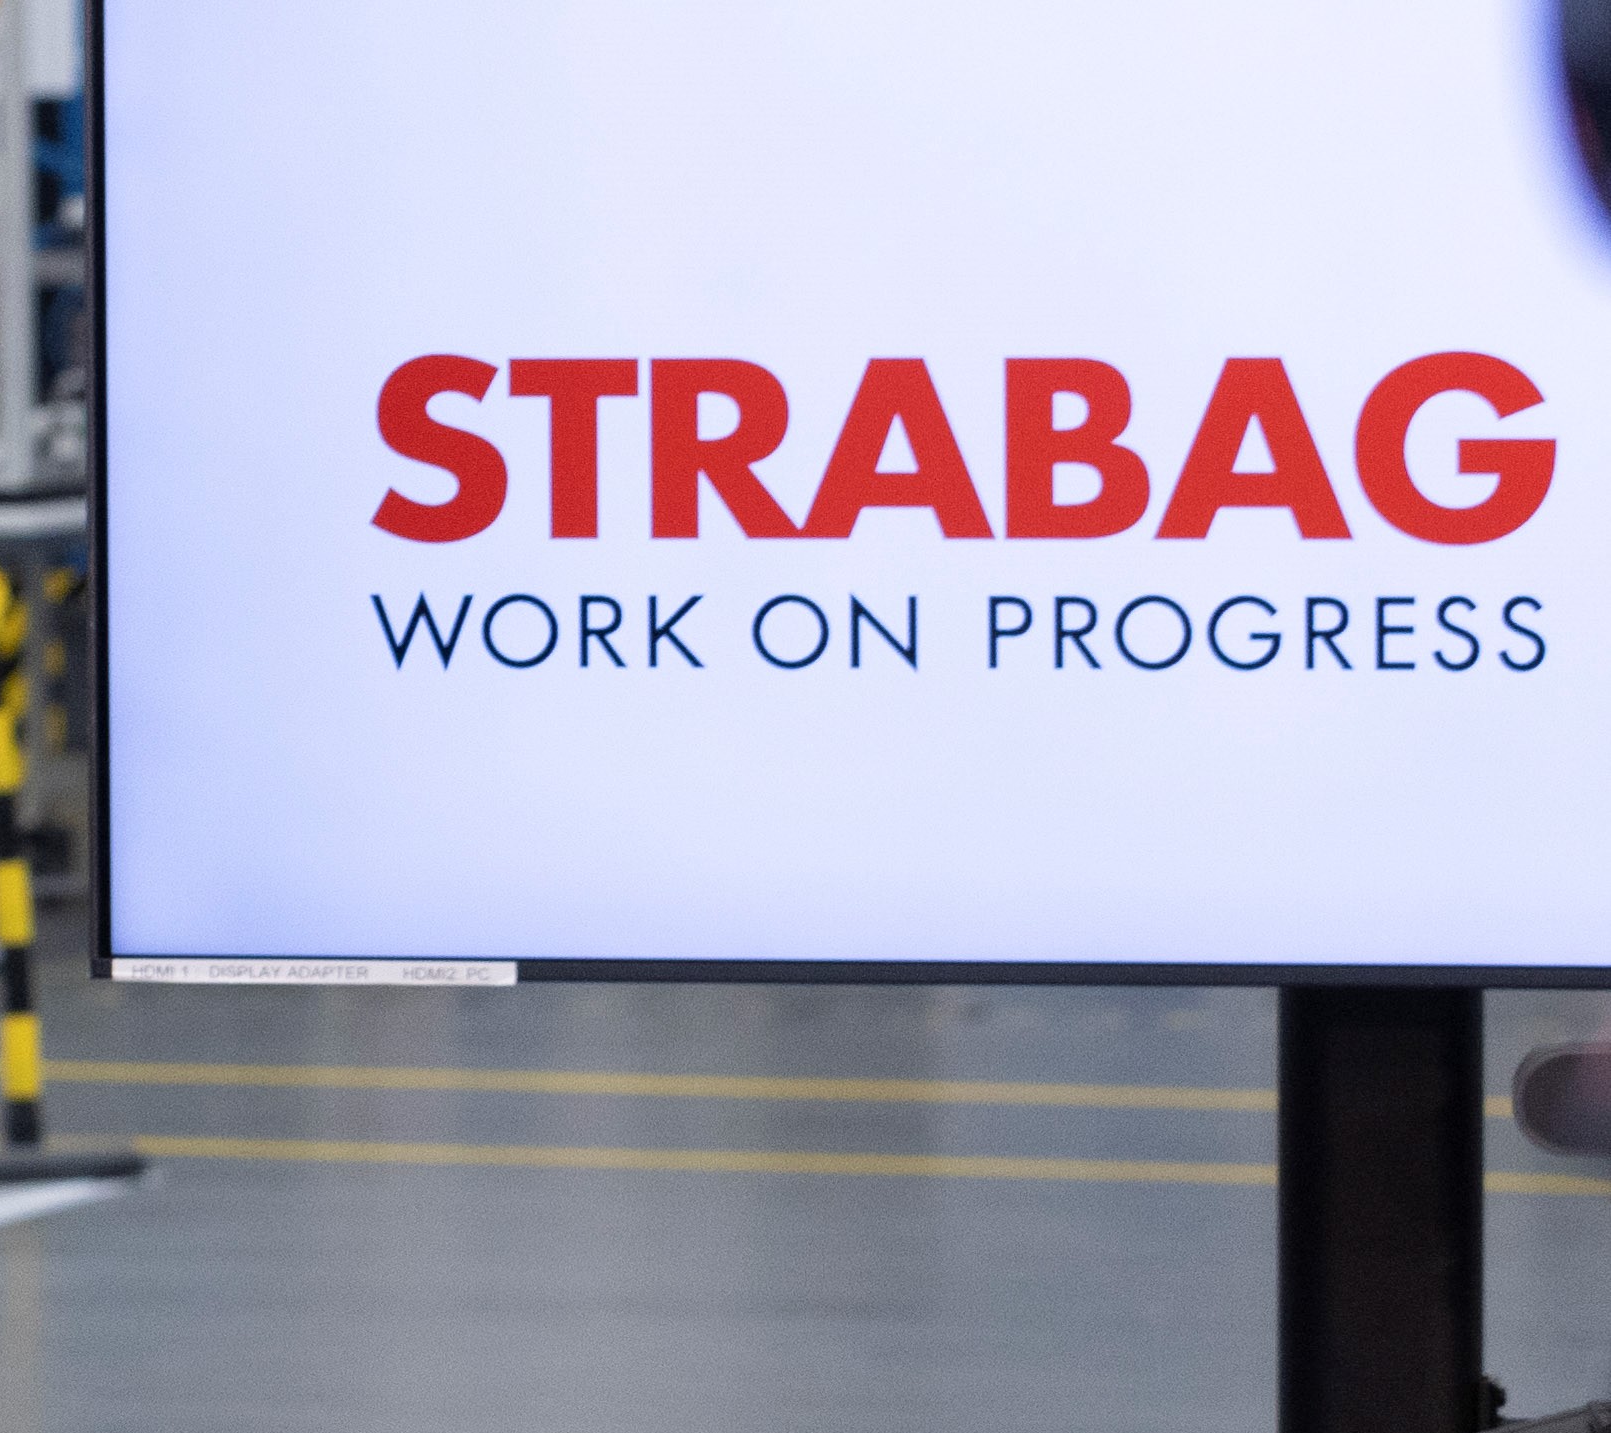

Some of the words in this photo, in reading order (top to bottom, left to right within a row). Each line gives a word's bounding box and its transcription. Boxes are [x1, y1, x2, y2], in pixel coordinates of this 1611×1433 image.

[370, 351, 1557, 545] STRABAG
[370, 593, 704, 672] WORK
[752, 594, 918, 672] ON
[988, 593, 1548, 672] PROGRESS
[209, 965, 280, 979] DISPLAY
[287, 966, 368, 980] ADAPTER
